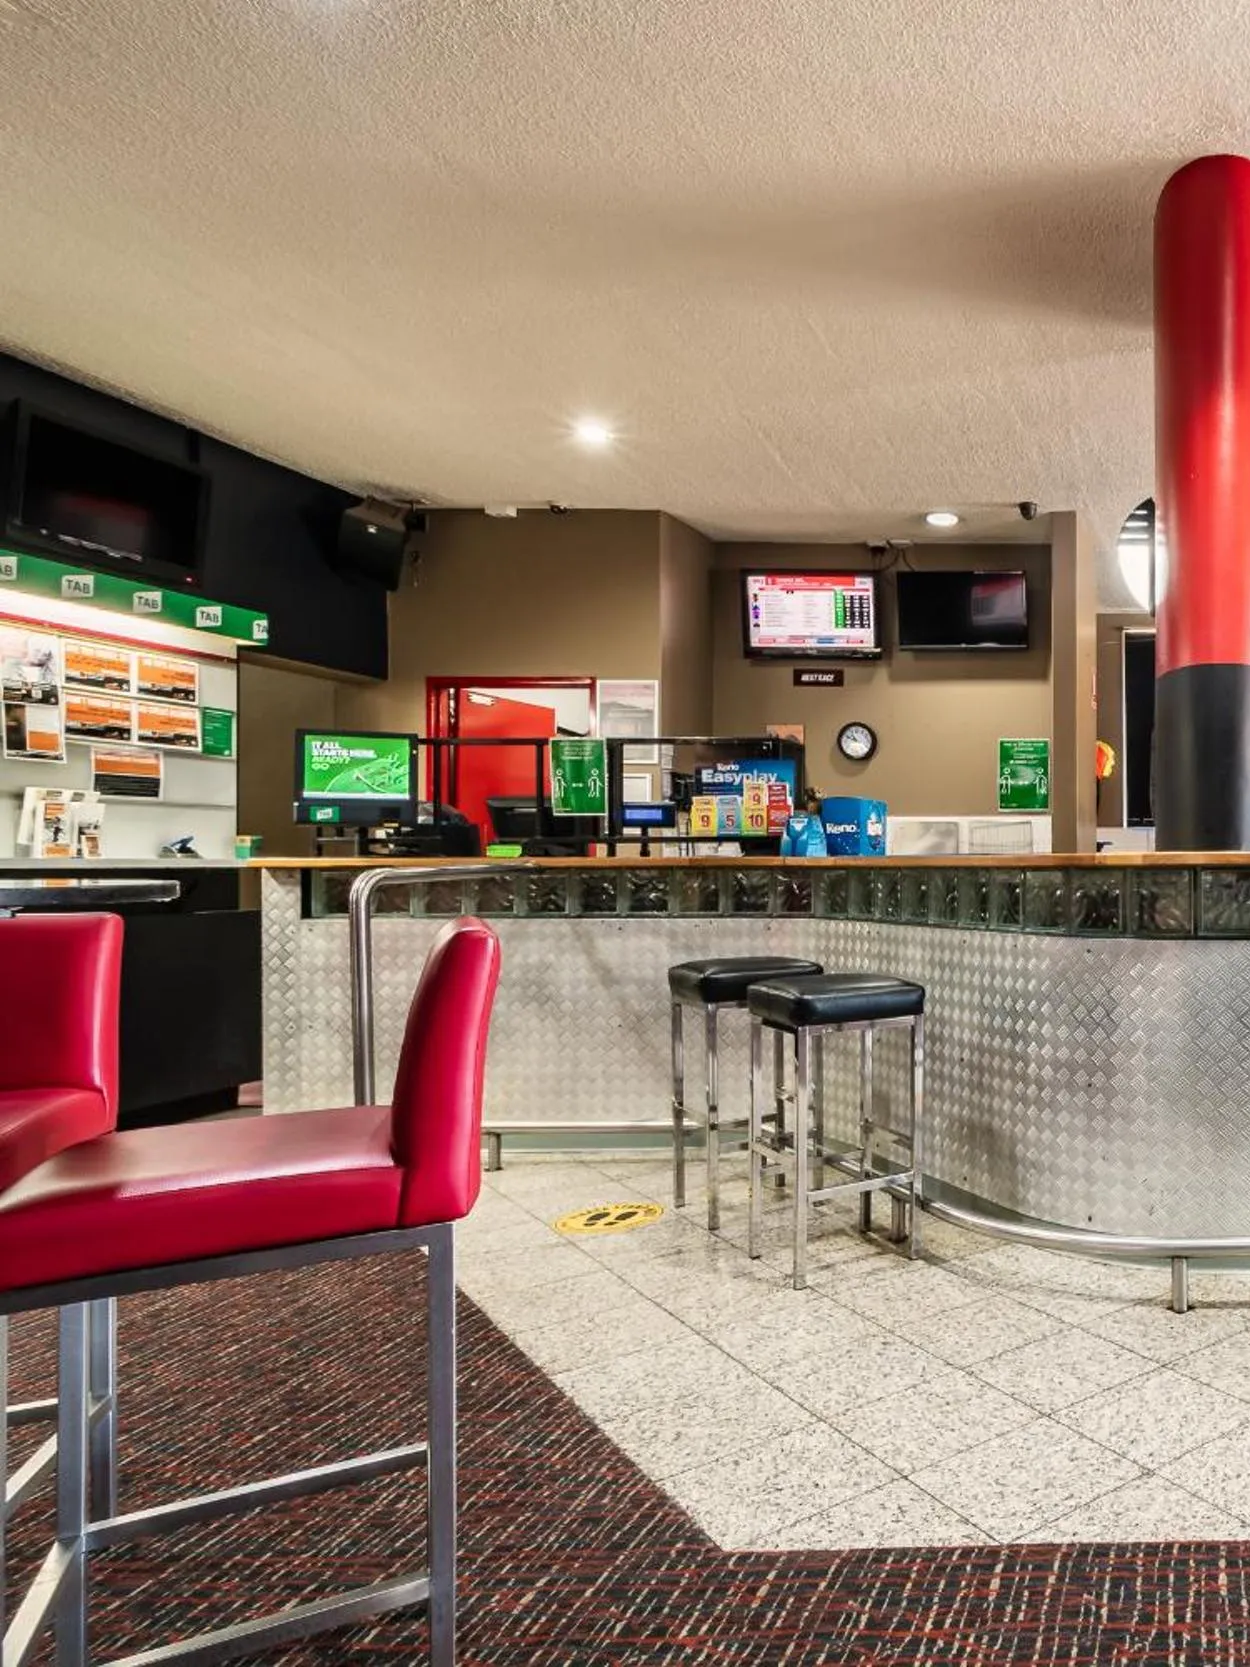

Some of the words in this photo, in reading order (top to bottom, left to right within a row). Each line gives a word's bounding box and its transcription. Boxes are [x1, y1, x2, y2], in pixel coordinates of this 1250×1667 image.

[66, 579, 91, 594] TAB
[136, 596, 160, 609] TAB
[200, 610, 219, 623] TAB
[701, 768, 778, 786] Easyplay
[725, 814, 736, 828] 5
[748, 814, 765, 828] 10
[826, 823, 857, 834] Keno
